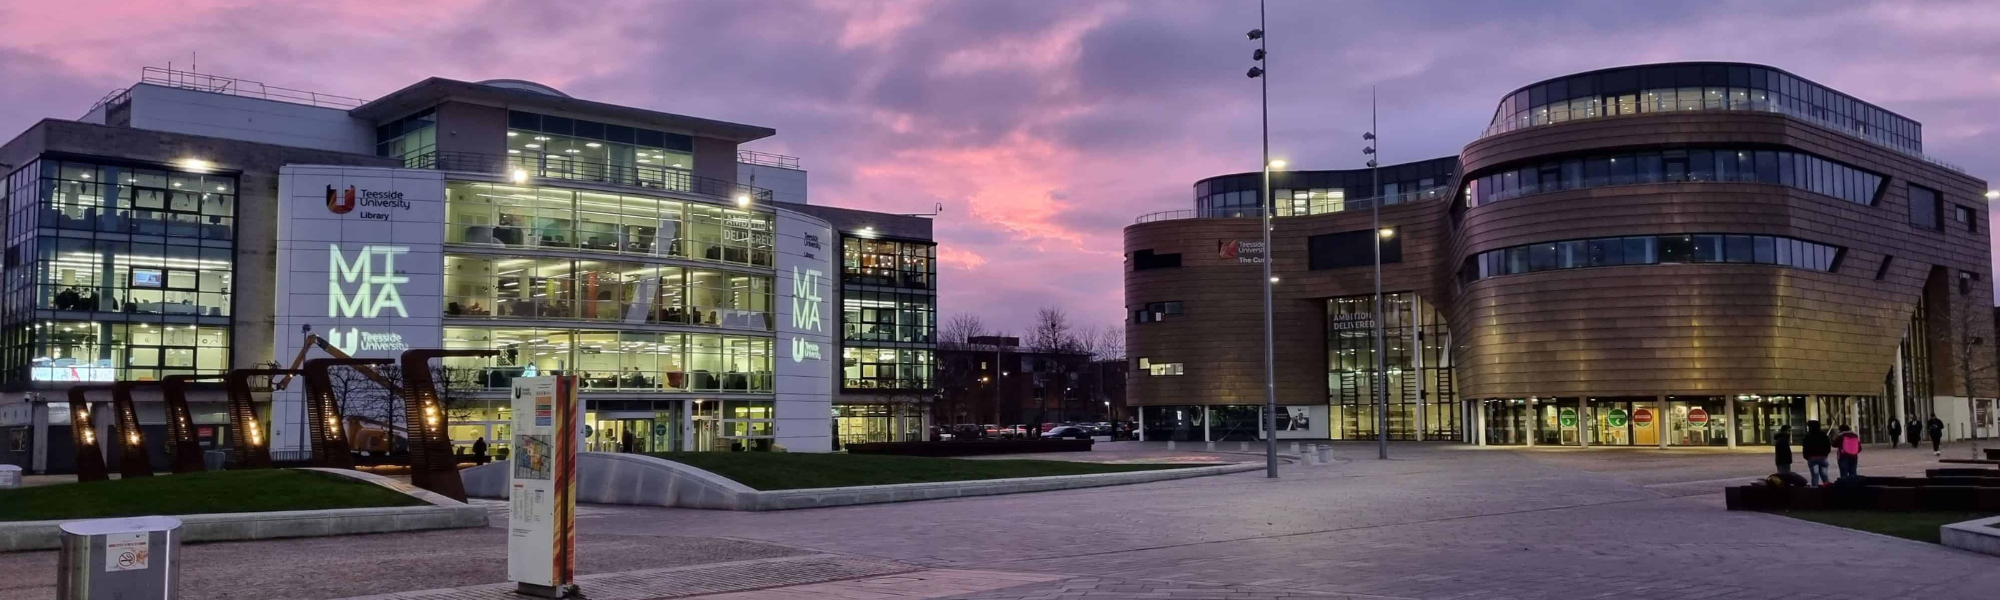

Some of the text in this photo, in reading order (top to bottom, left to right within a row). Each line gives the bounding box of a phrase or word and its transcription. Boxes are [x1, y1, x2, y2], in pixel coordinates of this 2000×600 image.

[360, 189, 404, 200] Teesside
[360, 198, 411, 211] University
[360, 211, 389, 222] Library
[726, 214, 774, 236] AMBTION
[1239, 256, 1273, 264] The Cure
[1333, 311, 1373, 322] AMBITION
[1333, 320, 1376, 330] DELIVERED
[360, 331, 403, 343] Teesside
